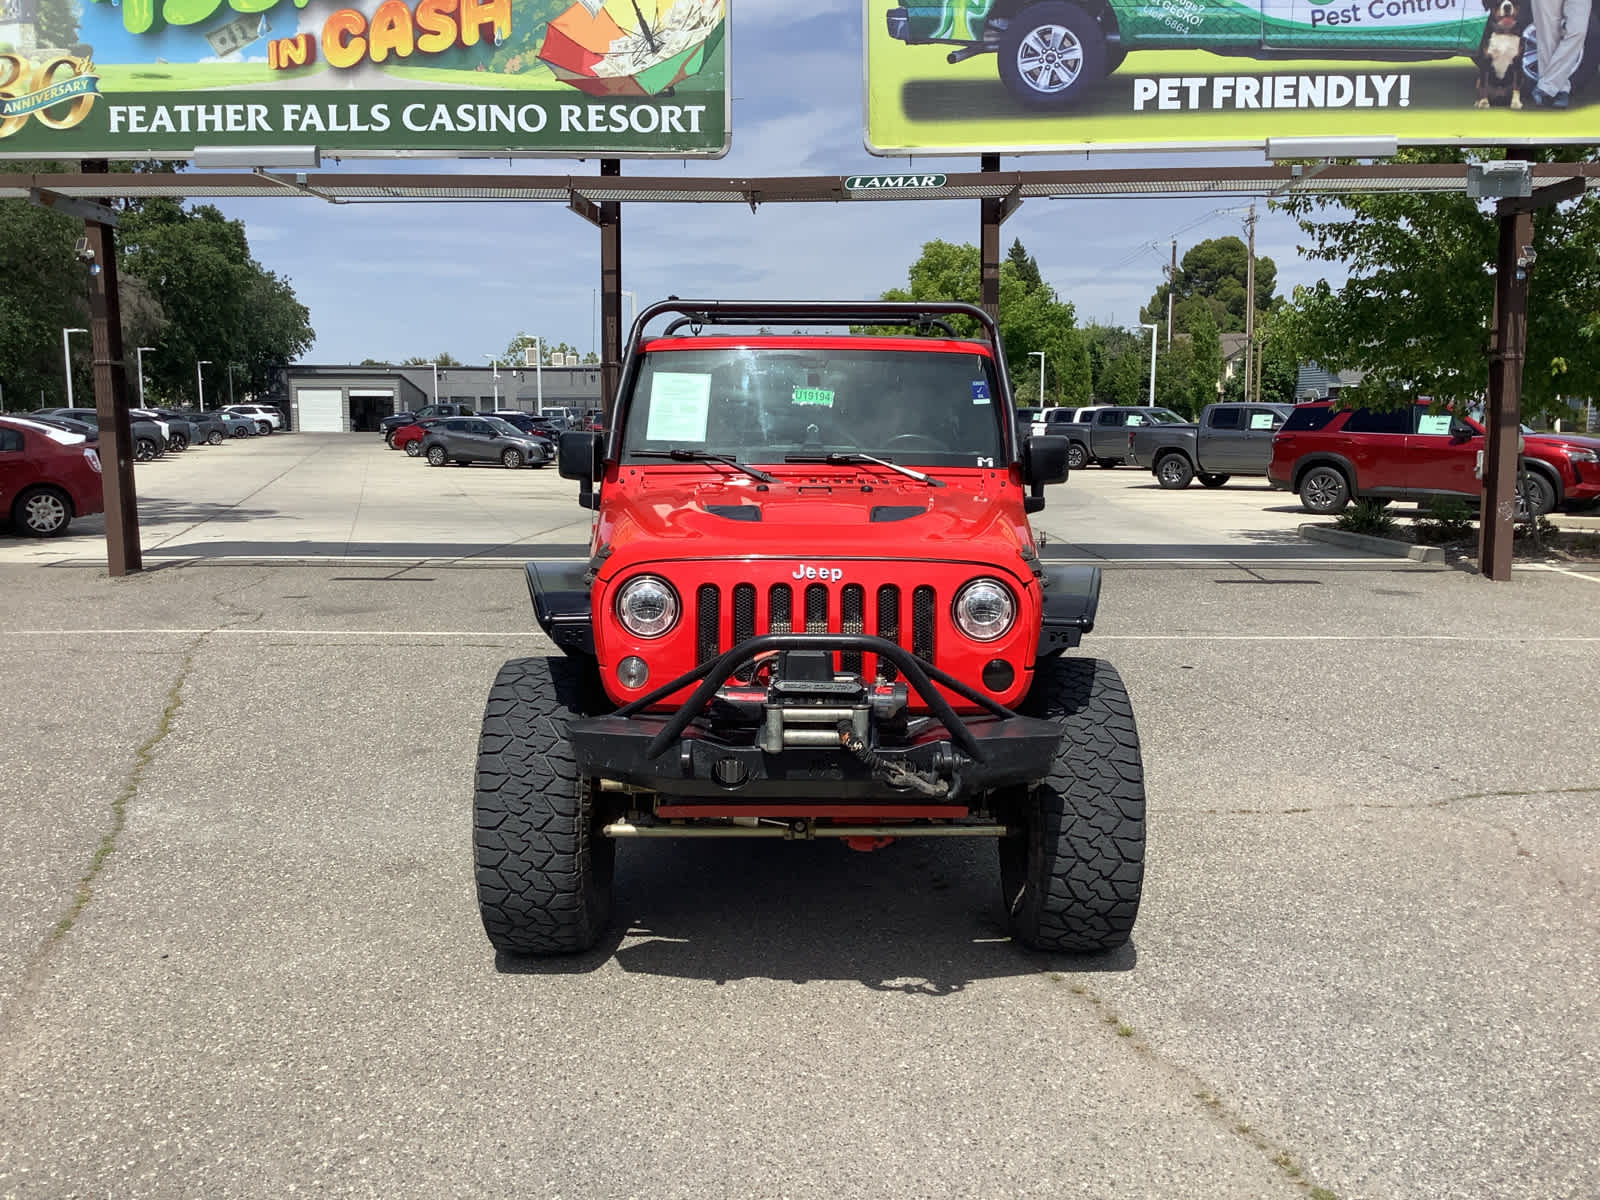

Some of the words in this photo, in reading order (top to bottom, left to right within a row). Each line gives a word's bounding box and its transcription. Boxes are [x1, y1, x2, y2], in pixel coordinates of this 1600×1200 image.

[1162, 1, 1204, 26] GECKO!
[1311, 4, 1361, 28] Pest
[267, 33, 314, 71] IN
[321, 0, 512, 68] CASH
[2, 79, 89, 114] ANNIVERSARY
[1133, 77, 1207, 112] PET
[1212, 75, 1411, 109] FRIENDLY!
[108, 105, 273, 134] FEATHER
[283, 104, 391, 132] FALLS
[402, 104, 548, 133] CASINO
[559, 105, 706, 133] RESORT
[853, 176, 937, 189] LAMAR
[792, 563, 843, 582] Jeep
